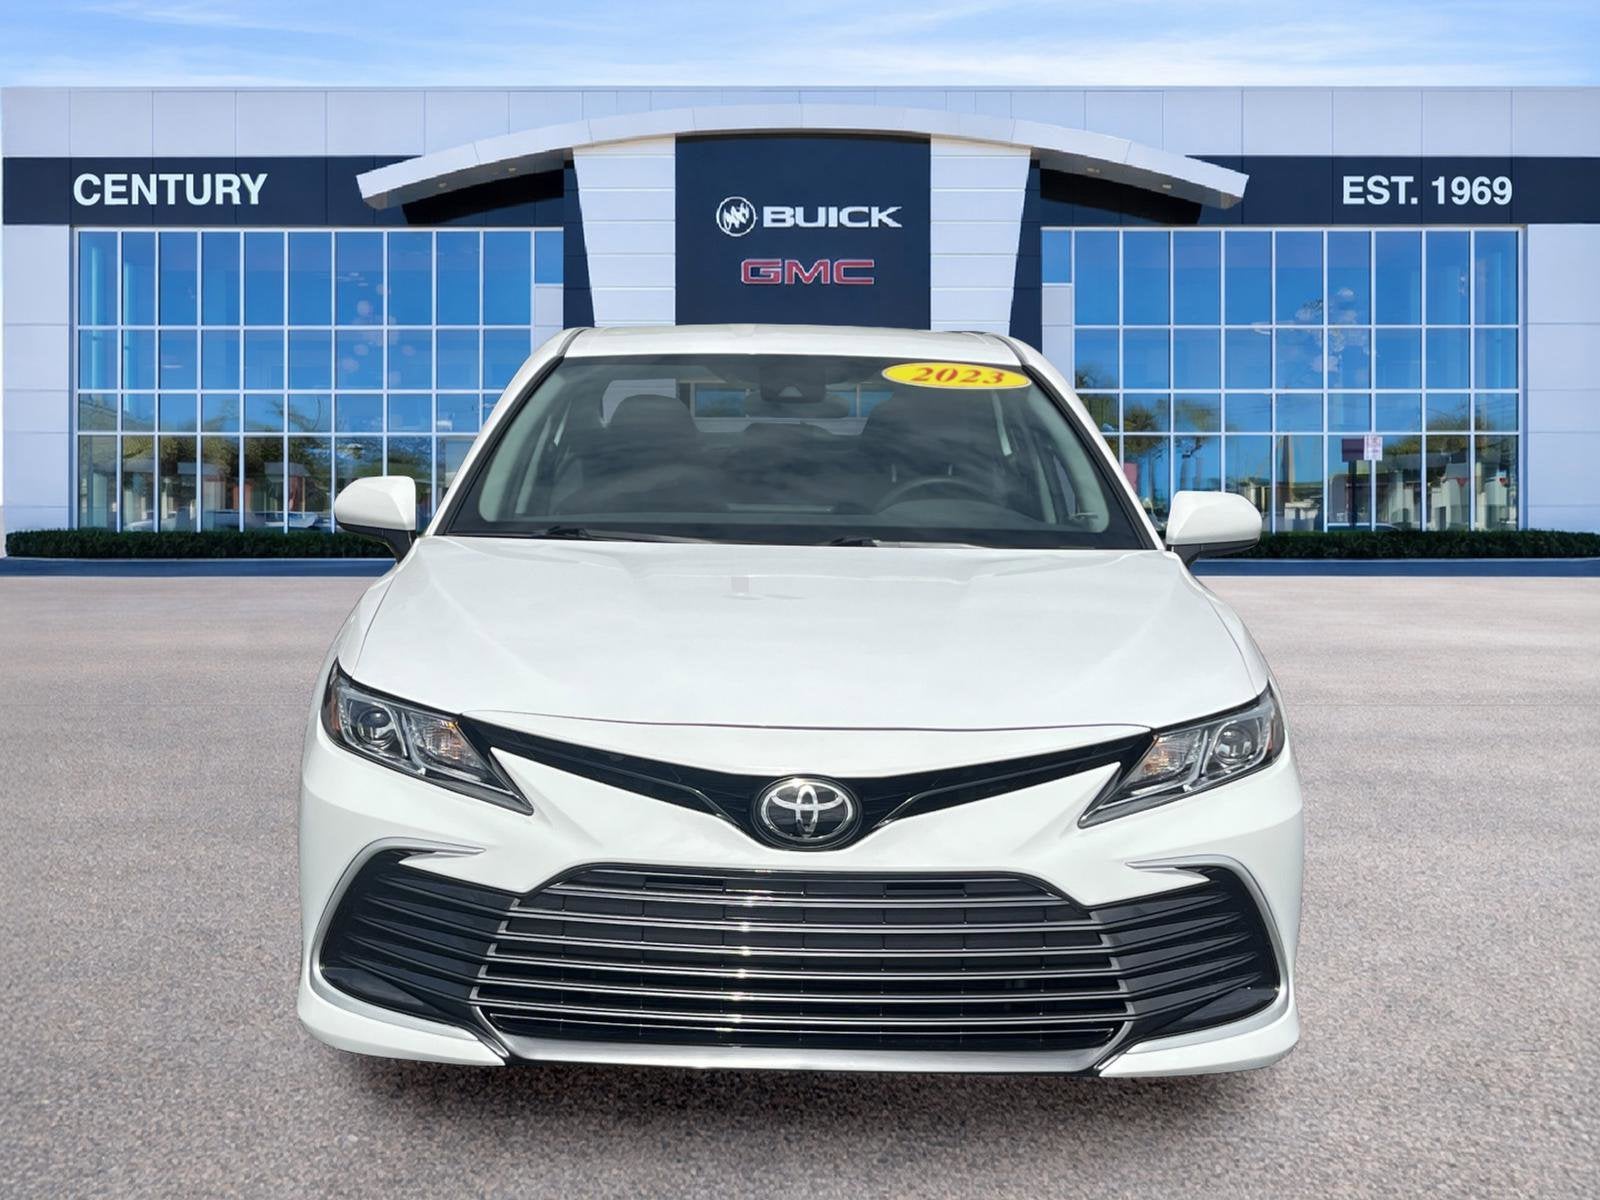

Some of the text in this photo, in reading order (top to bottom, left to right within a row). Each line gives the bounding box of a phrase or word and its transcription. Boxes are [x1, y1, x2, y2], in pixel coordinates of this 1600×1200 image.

[73, 173, 268, 206] CENTURY
[1342, 175, 1513, 206] EST. 1969
[762, 205, 903, 228] BUICK
[740, 258, 875, 285] GMC
[911, 366, 1005, 384] 2023
